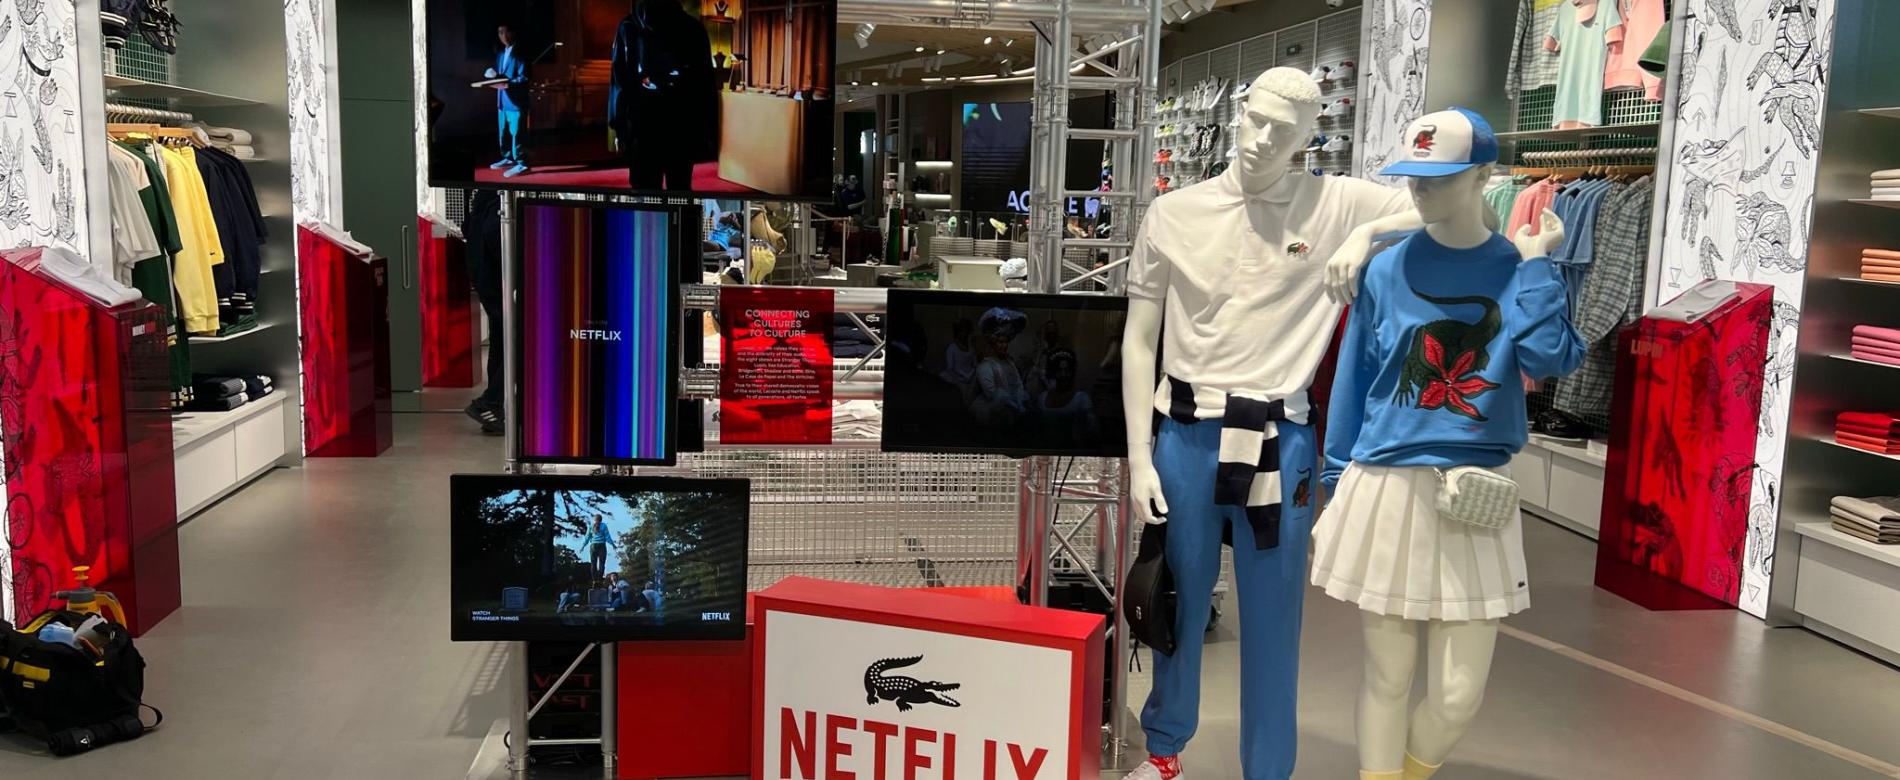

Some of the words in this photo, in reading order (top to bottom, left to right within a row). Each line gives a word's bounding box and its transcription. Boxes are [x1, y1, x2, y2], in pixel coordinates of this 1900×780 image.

[745, 309, 810, 319] CONNECTING
[753, 319, 802, 328] CULTURES
[569, 328, 623, 342] NETFLIX
[750, 329, 762, 337] TO
[764, 329, 807, 338] CULTURE
[701, 612, 731, 621] NETFLIX
[780, 706, 1048, 780] NETFLIX
